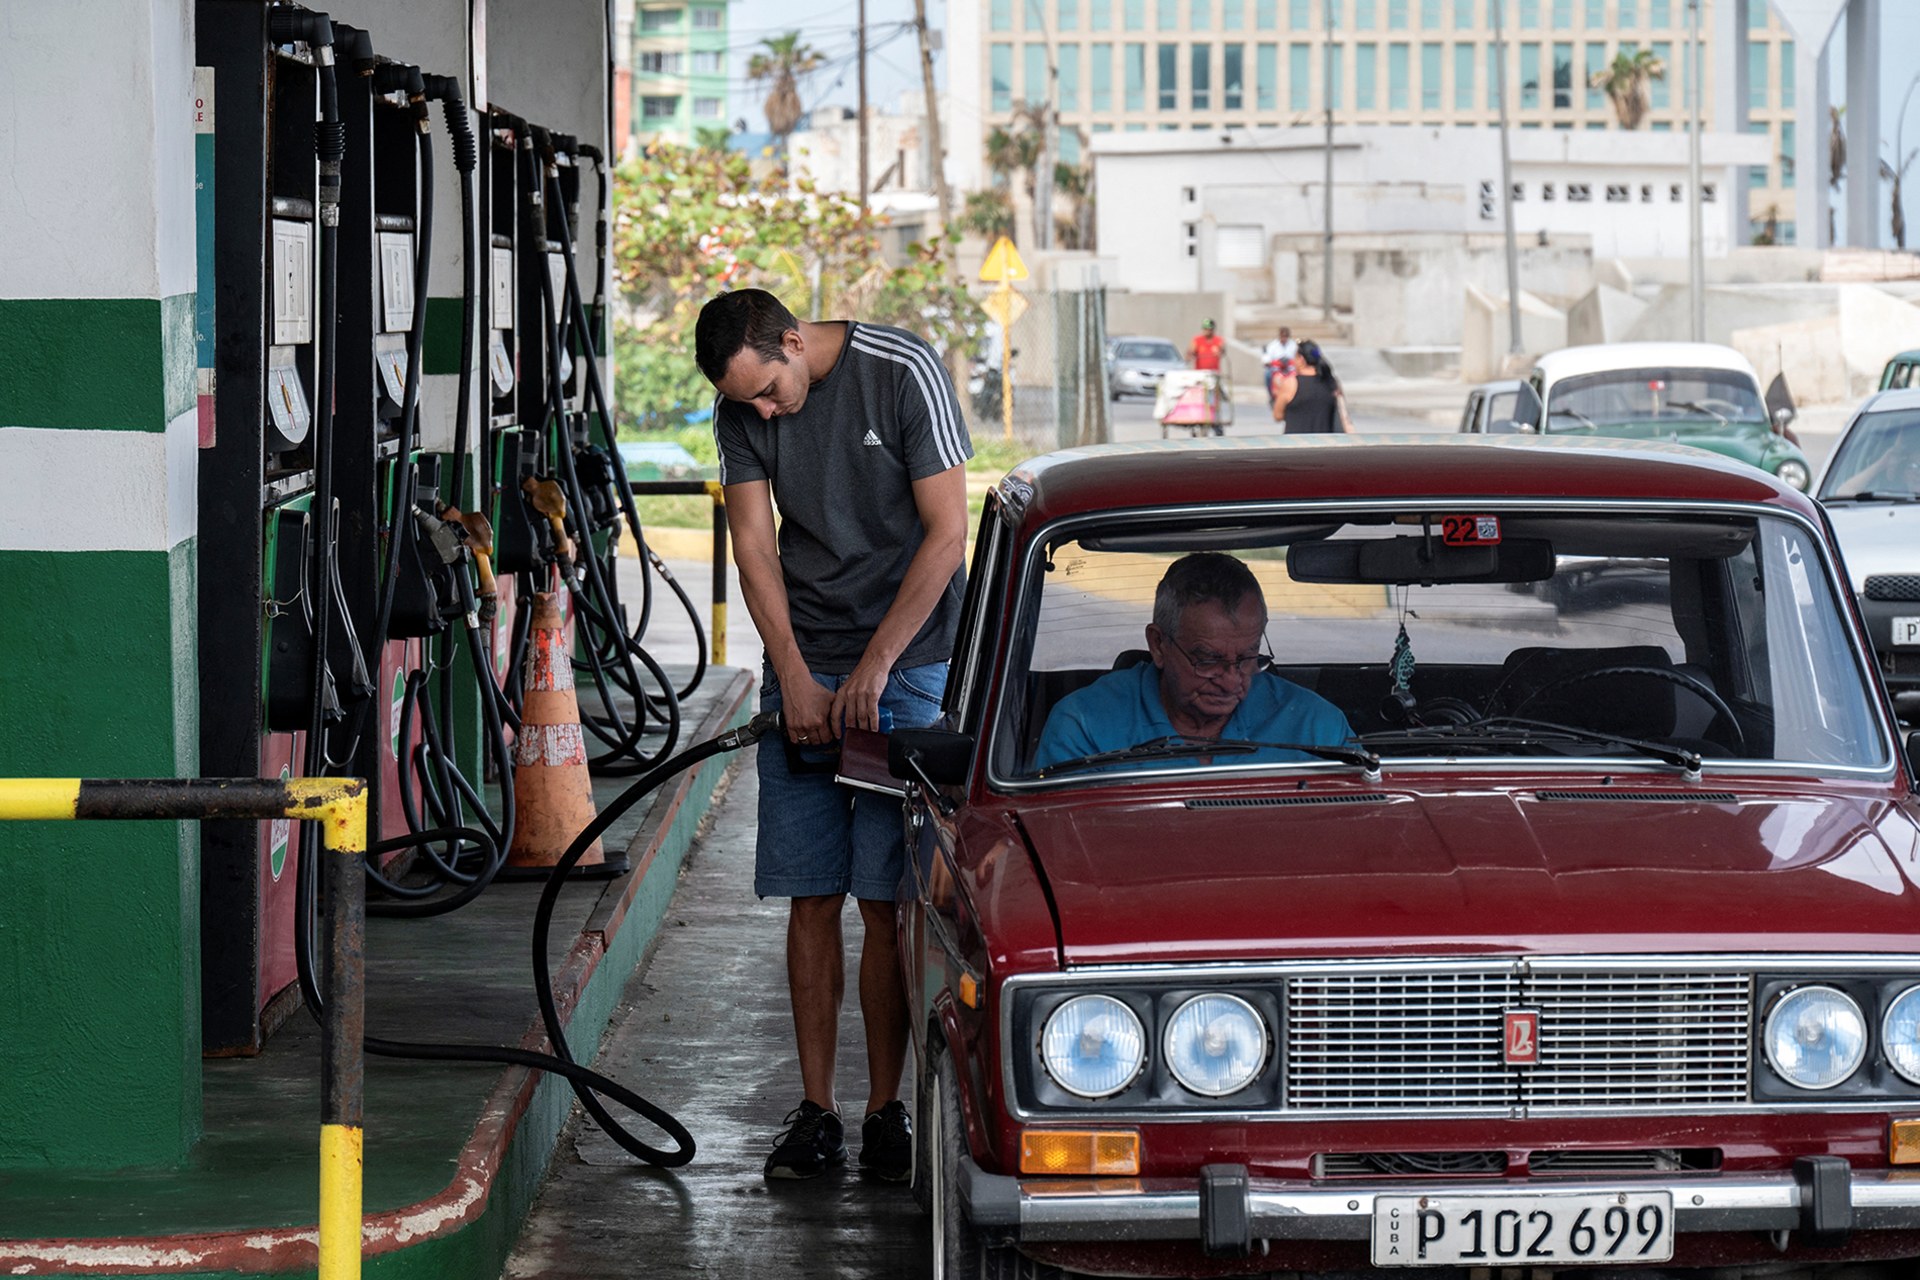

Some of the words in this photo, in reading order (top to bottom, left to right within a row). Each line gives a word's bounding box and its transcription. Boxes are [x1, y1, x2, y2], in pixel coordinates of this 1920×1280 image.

[1445, 518, 1478, 542] 22
[1389, 1207, 1400, 1256] CUBA
[1459, 1208, 1554, 1258] 102
[1569, 1204, 1663, 1257] 699
